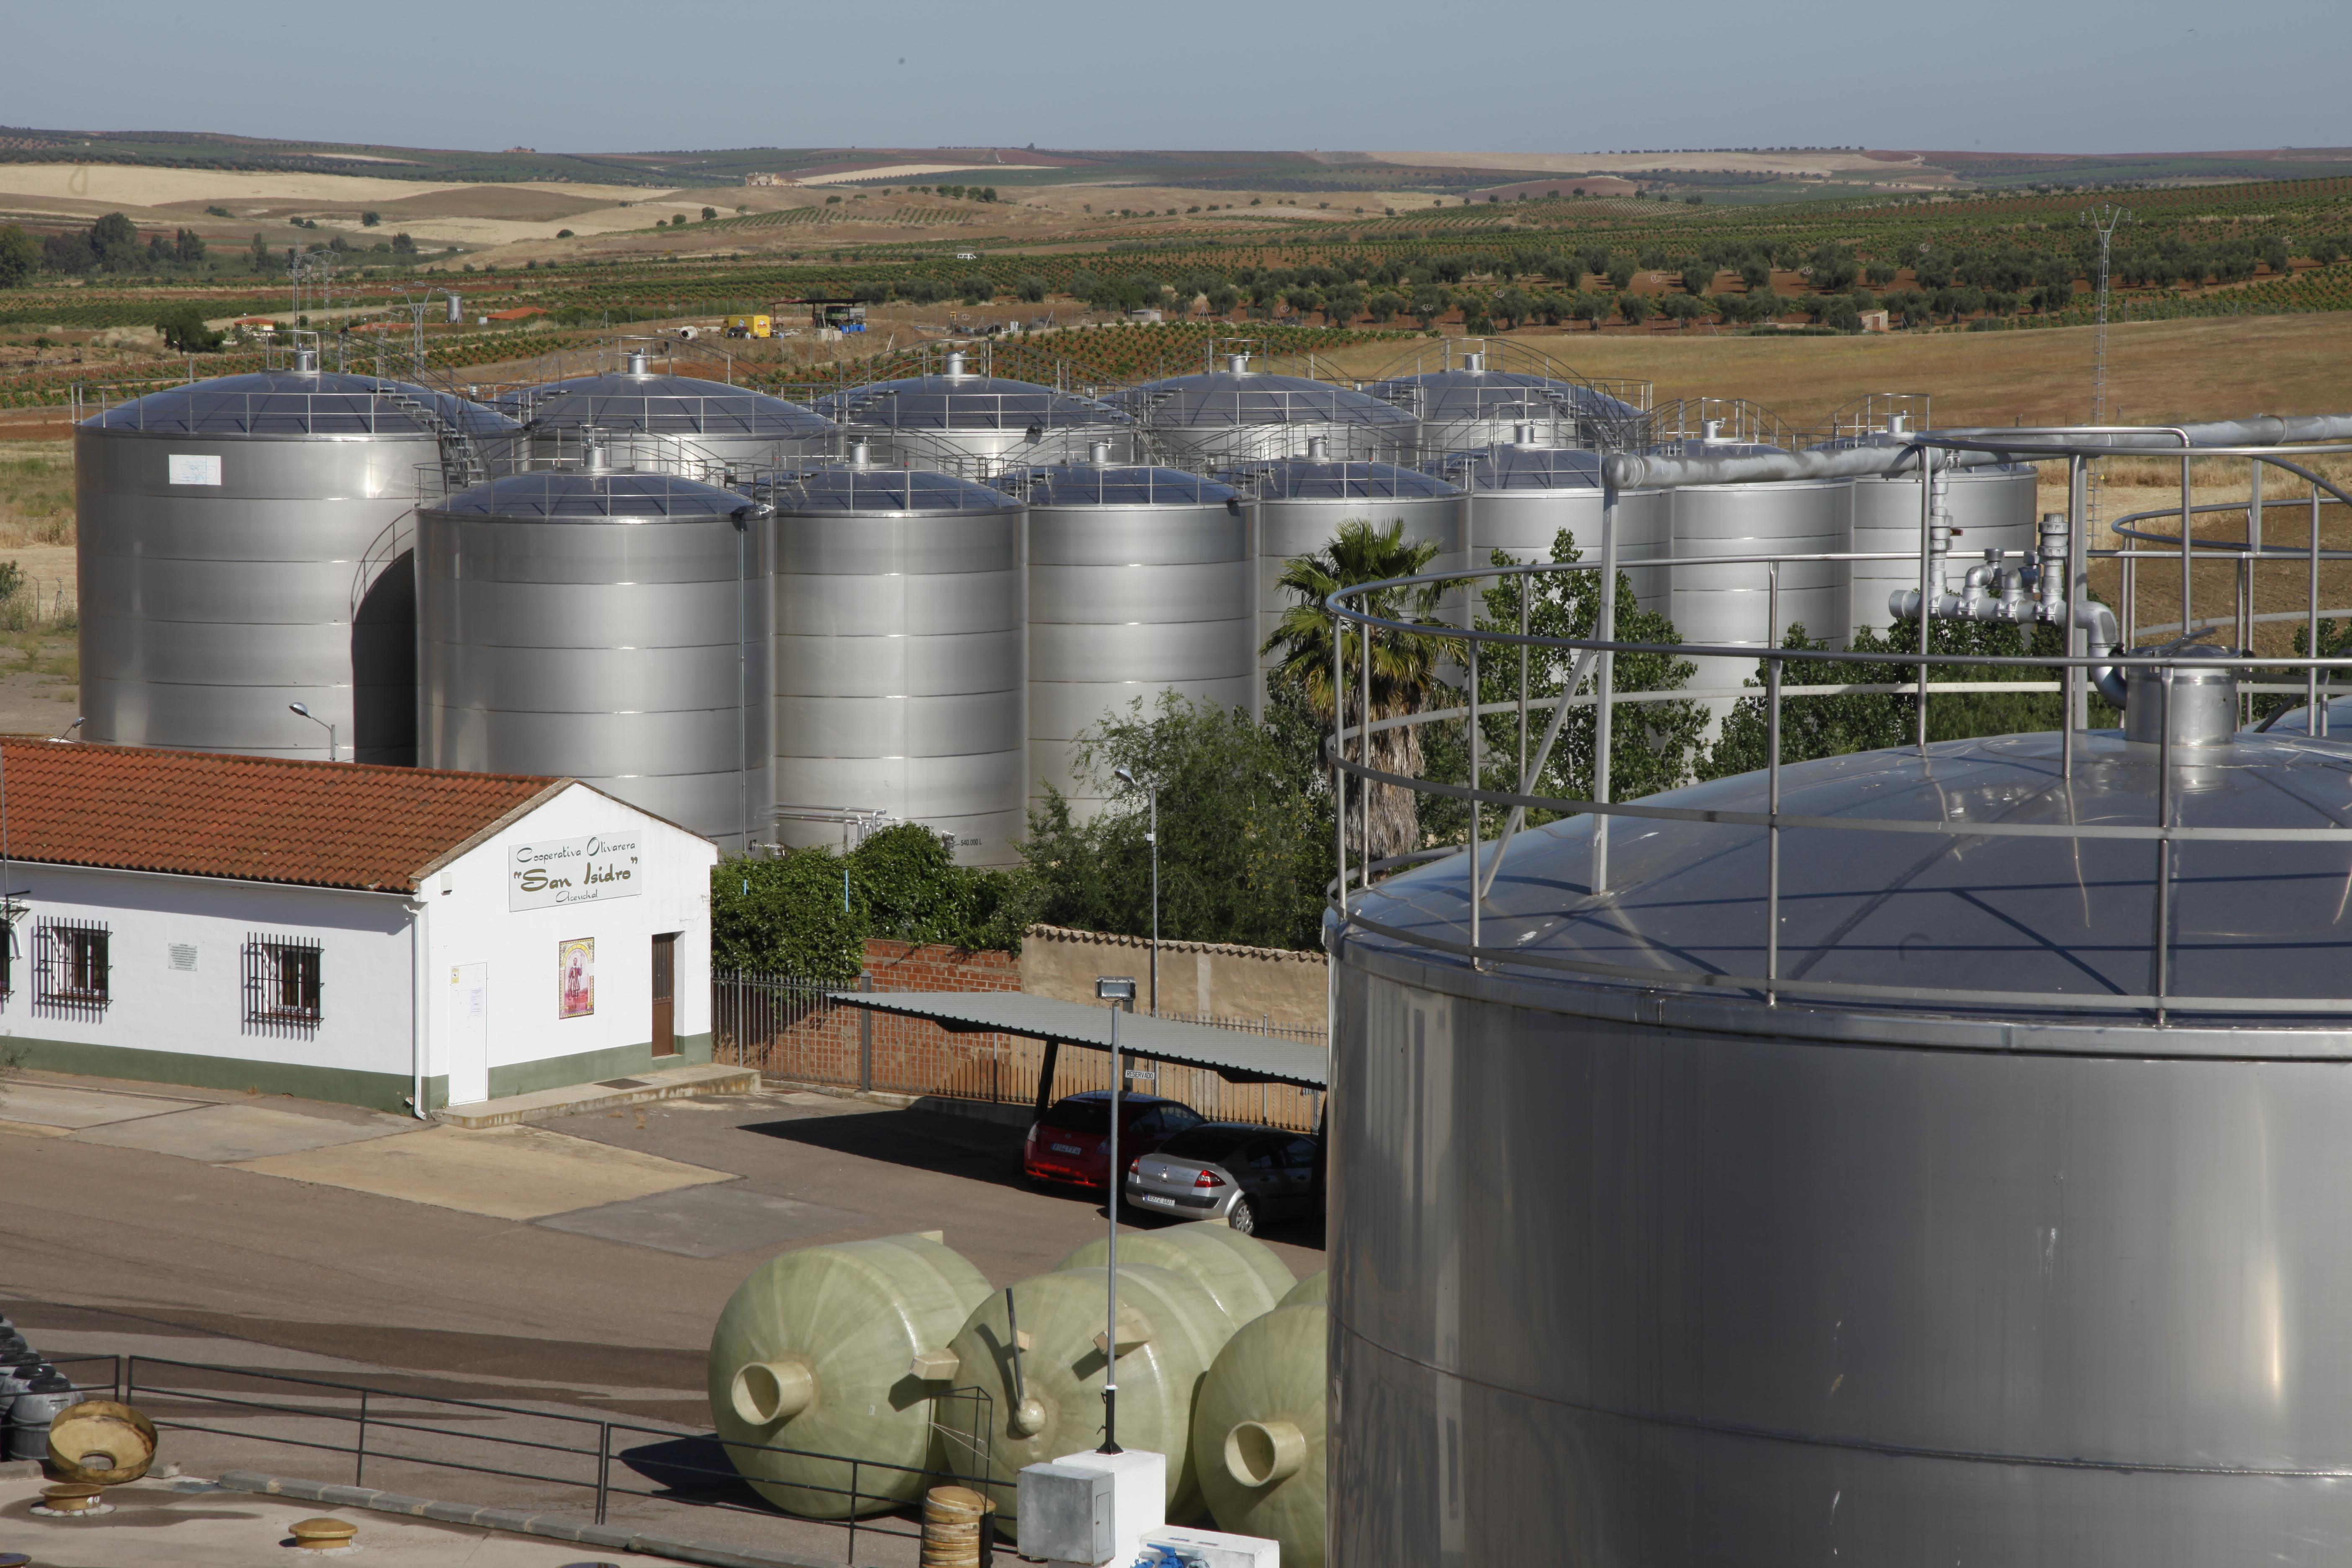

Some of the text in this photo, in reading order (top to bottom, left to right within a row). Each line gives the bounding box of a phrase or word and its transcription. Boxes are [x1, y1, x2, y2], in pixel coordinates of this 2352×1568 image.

[516, 837, 636, 864] Cooperativa Olivarera
[748, 839, 757, 852] 47
[555, 889, 598, 903] Aceuchal
[1127, 1070, 1153, 1079] RESERVADO
